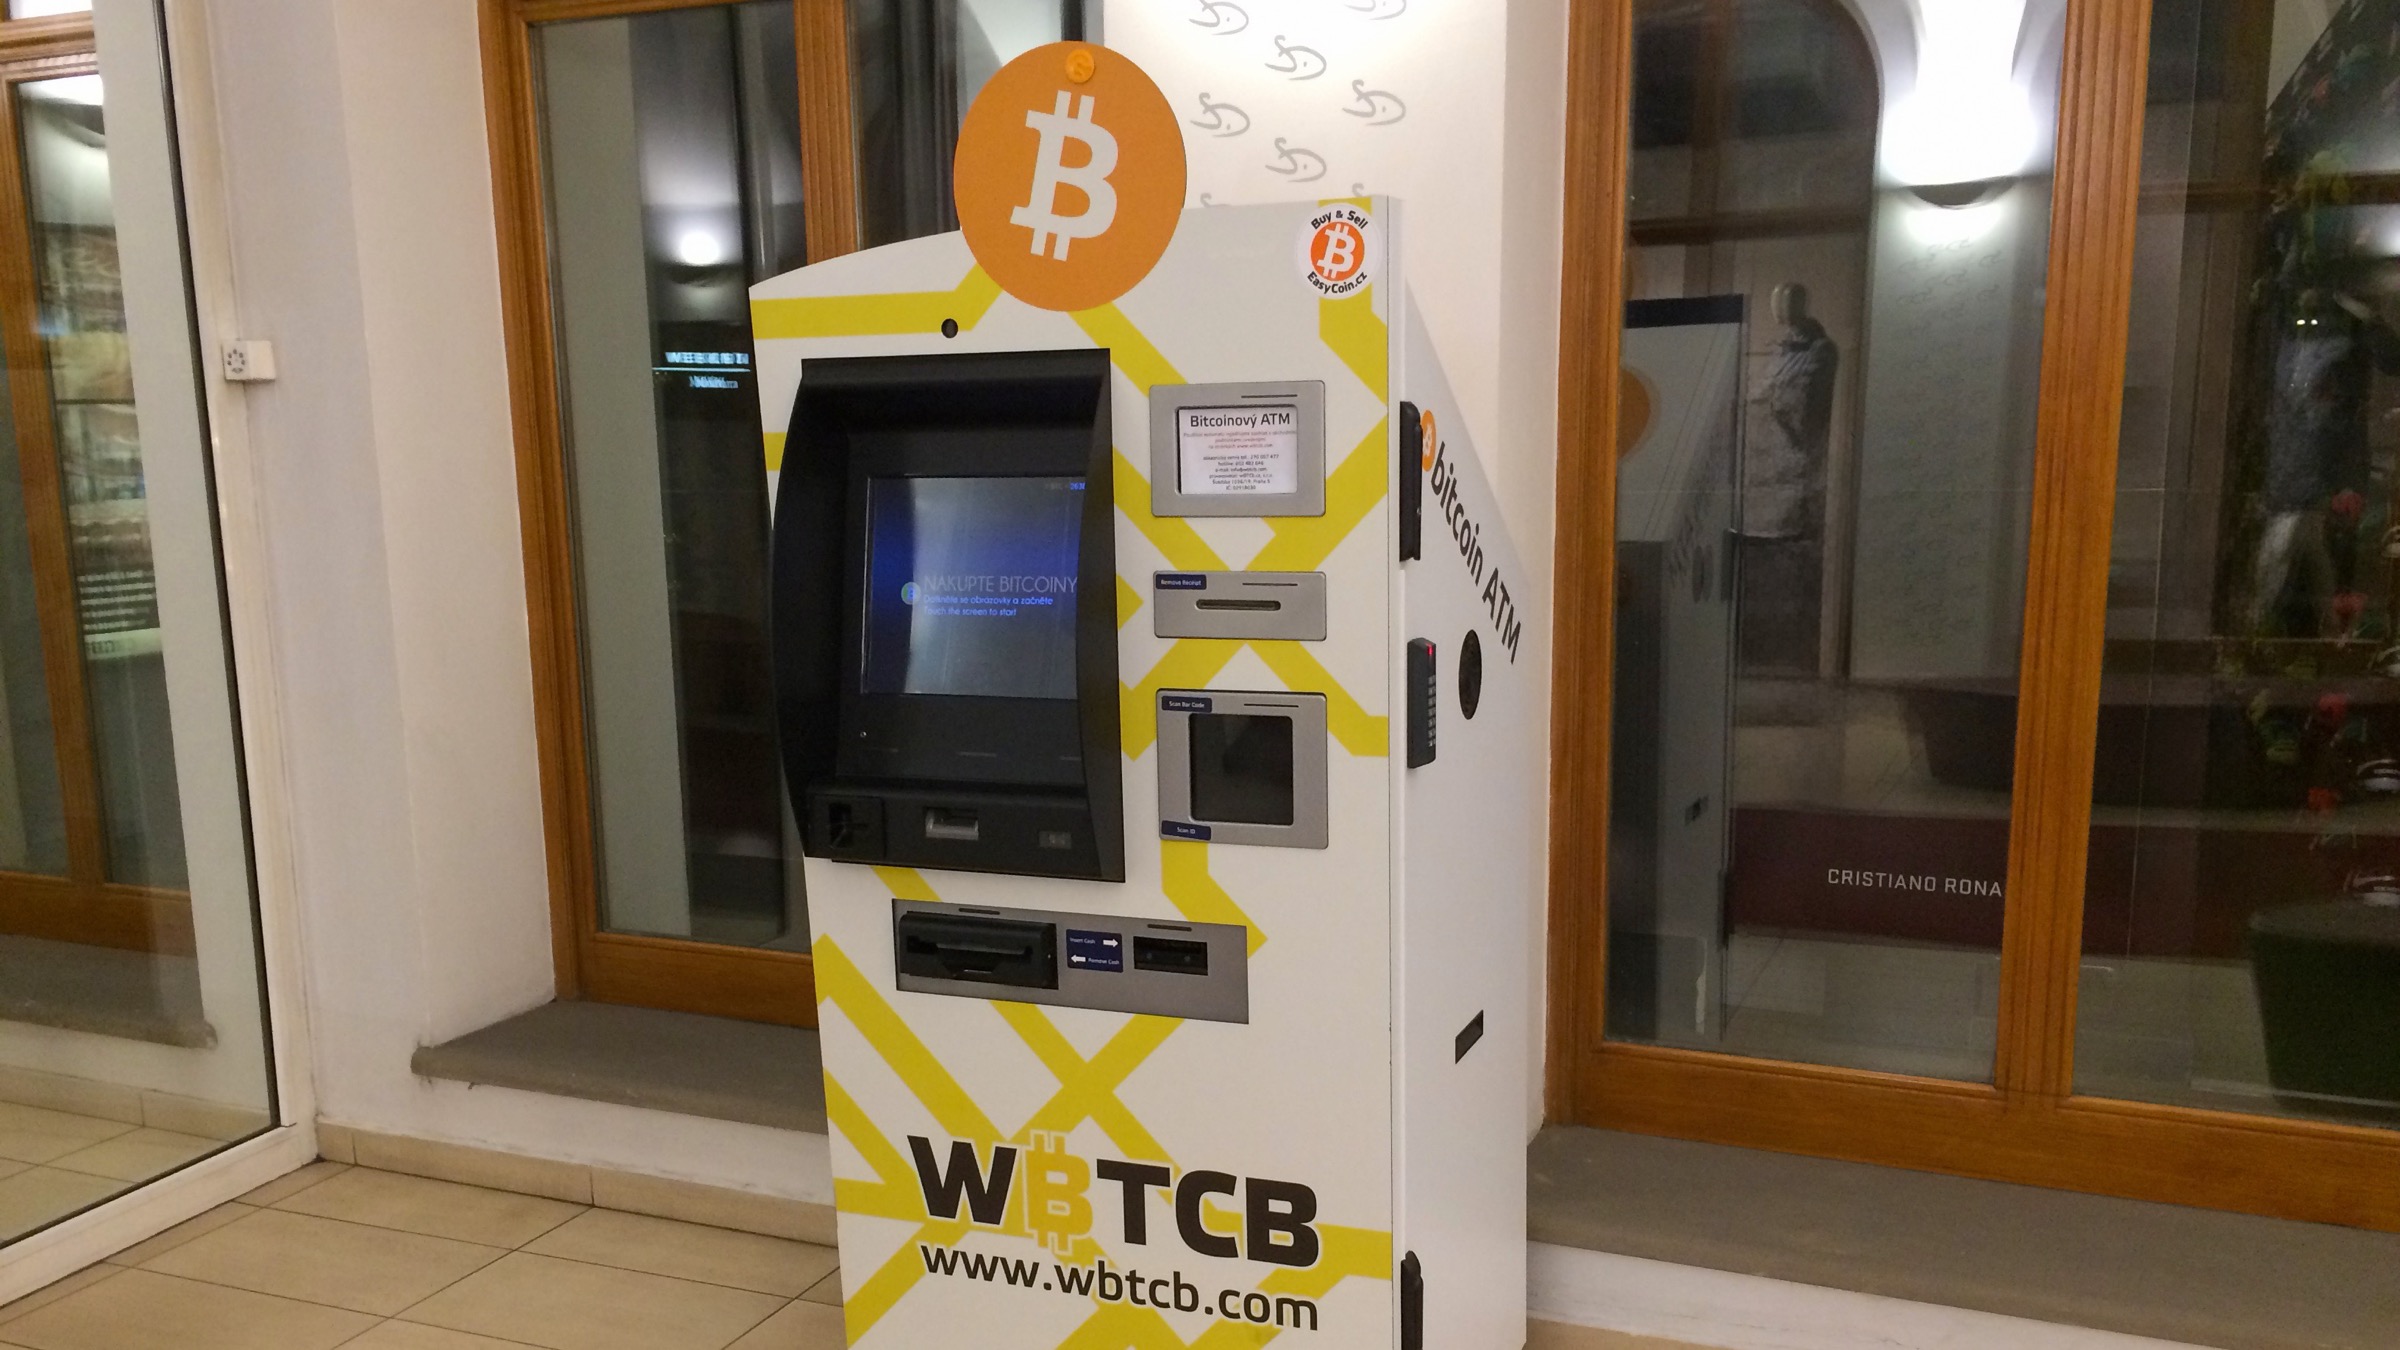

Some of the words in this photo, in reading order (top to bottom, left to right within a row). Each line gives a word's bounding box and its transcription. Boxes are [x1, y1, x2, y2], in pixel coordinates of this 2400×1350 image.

[1311, 212, 1332, 230] Buy
[1335, 210, 1343, 219] &
[1347, 210, 1369, 230] Sell
[1307, 271, 1368, 294] EasyCoin.cz
[1190, 414, 1257, 428] Bitcoinový
[1260, 413, 1290, 426] ATM
[1430, 440, 1484, 587] bitcoin
[1481, 566, 1522, 666] ATM
[923, 575, 994, 593] NAKUPTE
[999, 575, 1078, 594] BITCOINY
[923, 605, 946, 616] Touch
[962, 608, 988, 616] screen
[989, 607, 998, 616] to
[999, 608, 1017, 617] start
[1012, 597, 1019, 605] a
[1827, 868, 1937, 892] CRISTIANO
[1944, 877, 2002, 897] RONA
[906, 1128, 1320, 1268] WBTCB
[920, 1244, 1319, 1331] www.wbtcb.com
